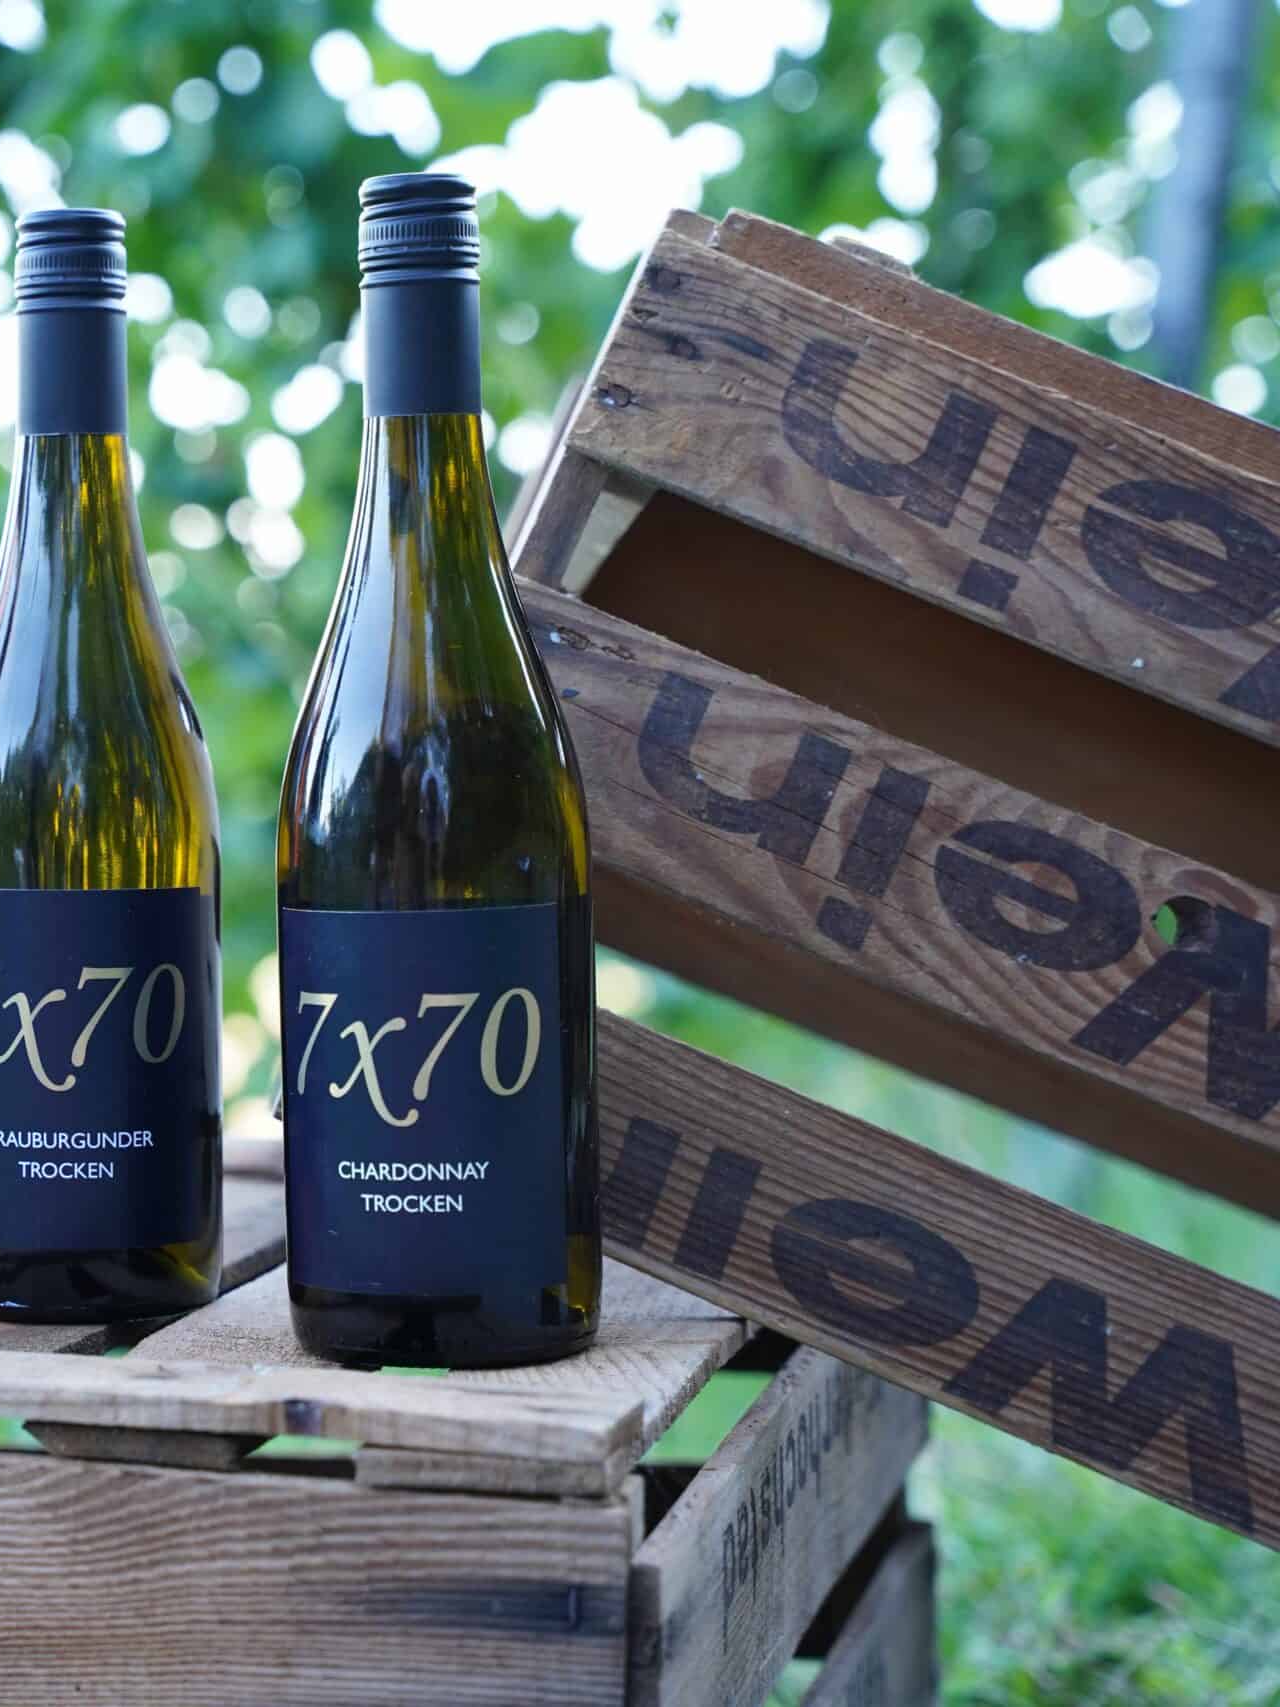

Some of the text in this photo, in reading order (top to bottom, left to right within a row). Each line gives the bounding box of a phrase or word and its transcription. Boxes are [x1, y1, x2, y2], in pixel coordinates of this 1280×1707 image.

[782, 337, 1280, 722] ein
[296, 987, 542, 1128] 7x70
[18, 1161, 115, 1179] TROCKEN
[337, 1160, 489, 1181] CHARDONNAY
[360, 1193, 463, 1213] TROCKEN
